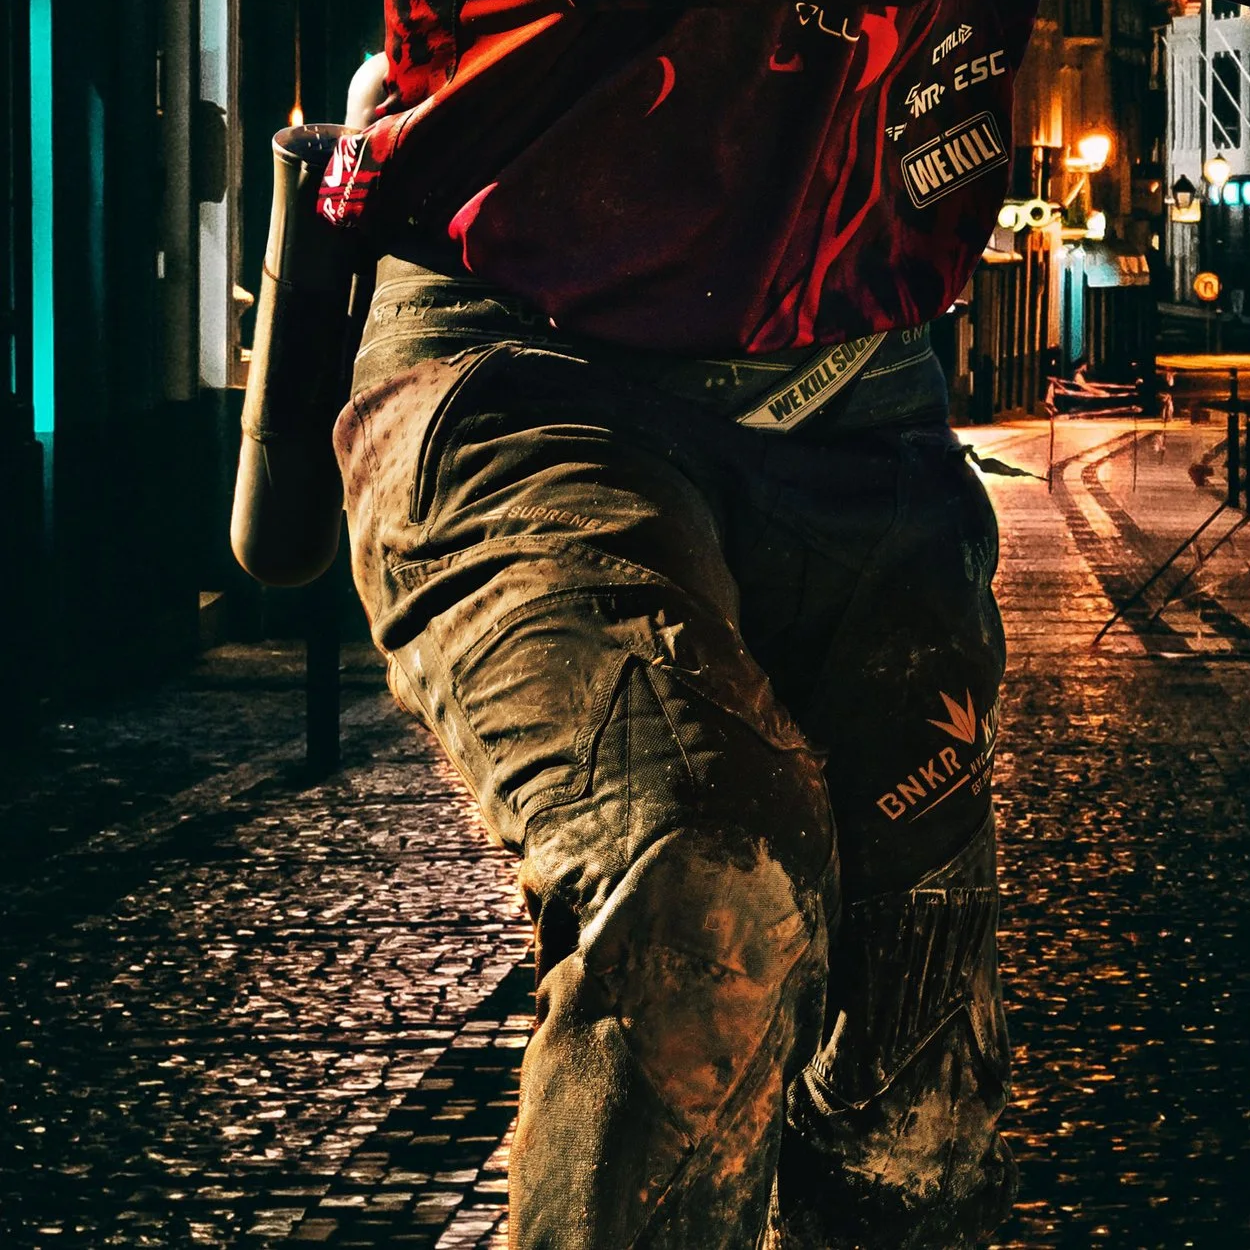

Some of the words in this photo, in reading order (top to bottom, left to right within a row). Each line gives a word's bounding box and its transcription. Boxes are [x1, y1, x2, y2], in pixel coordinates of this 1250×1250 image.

[954, 49, 1006, 92] ESC
[908, 147, 955, 196] WE
[768, 388, 803, 422] WE
[797, 362, 838, 402] KILL
[875, 746, 962, 821] BNKR
